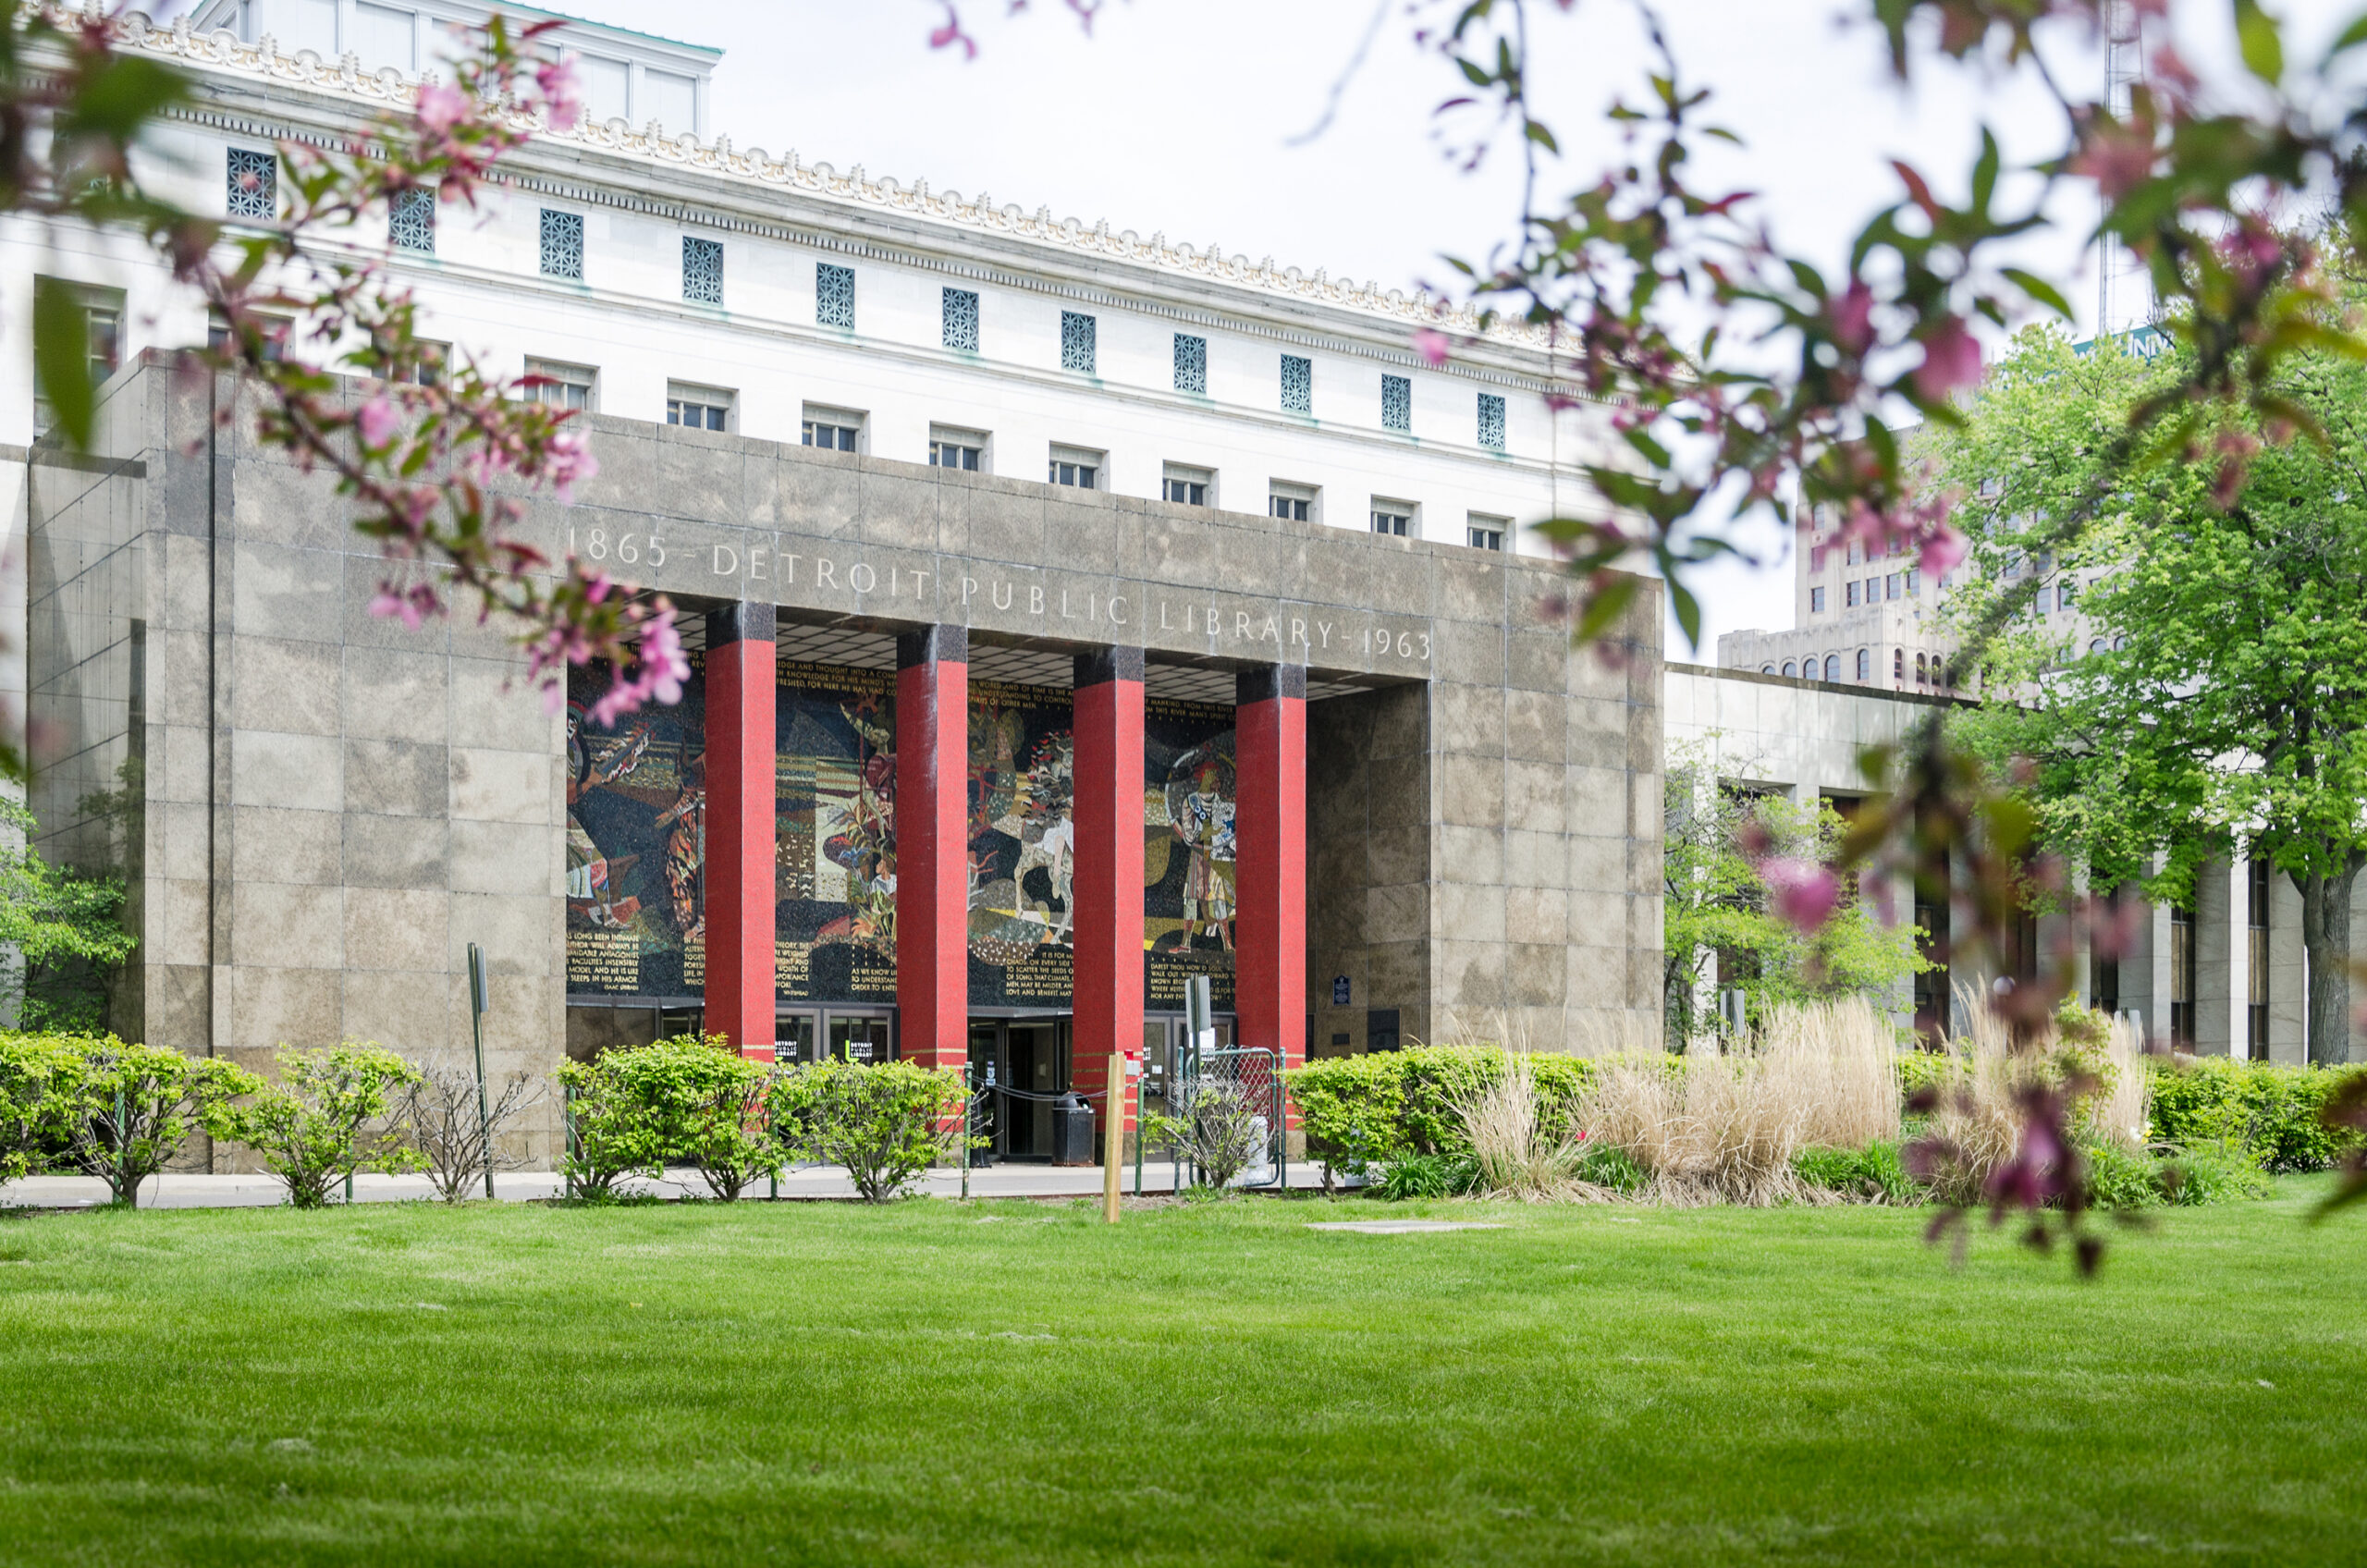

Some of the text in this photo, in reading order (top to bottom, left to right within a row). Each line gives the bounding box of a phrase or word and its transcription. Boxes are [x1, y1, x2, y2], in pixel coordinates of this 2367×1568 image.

[569, 525, 666, 568] 1865
[713, 545, 930, 600] DETROIT
[962, 576, 1127, 625] PUBLIC
[1160, 602, 1333, 648] LIBRARY
[1363, 628, 1431, 660] 1963
[808, 680, 821, 689] FOR
